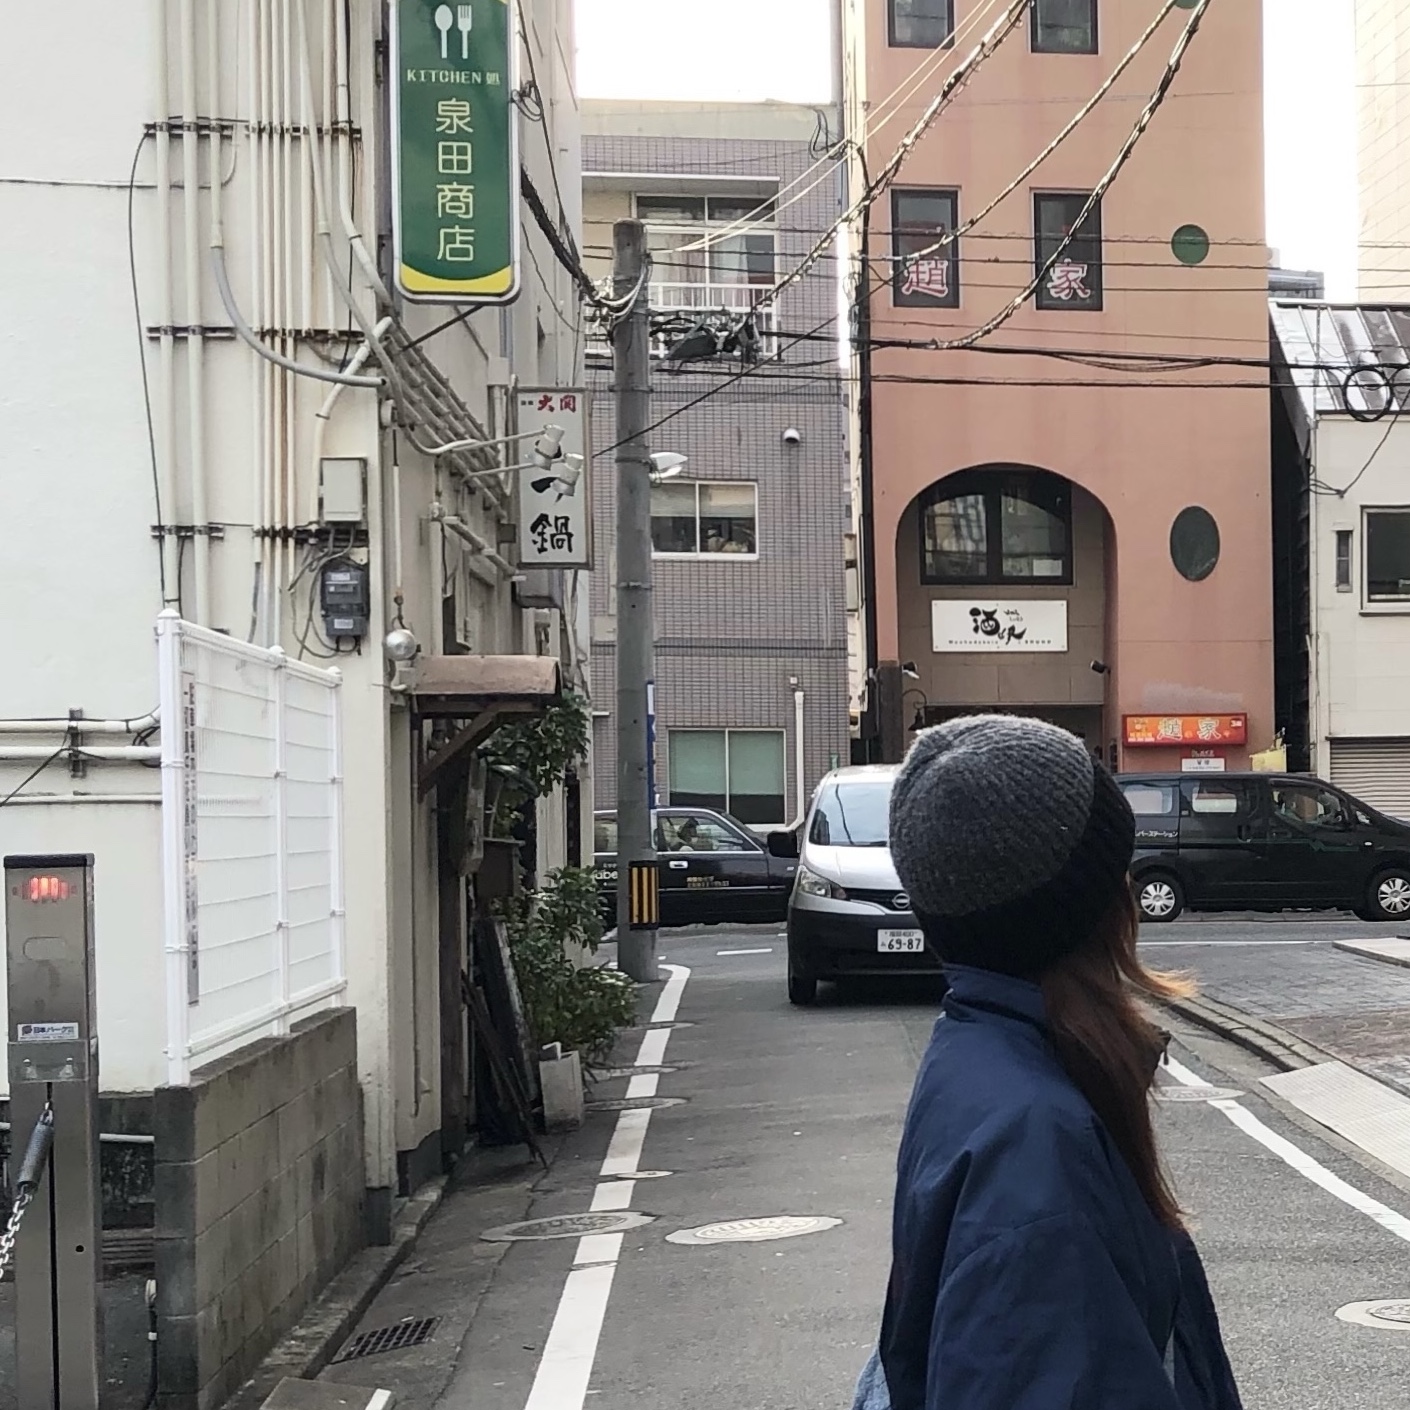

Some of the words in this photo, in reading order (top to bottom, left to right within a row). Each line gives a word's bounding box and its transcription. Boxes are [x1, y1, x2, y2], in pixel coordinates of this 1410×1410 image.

[407, 69, 482, 84] KITCHEN
[435, 97, 475, 262] 泉田商店
[888, 938, 922, 950] 69-87
